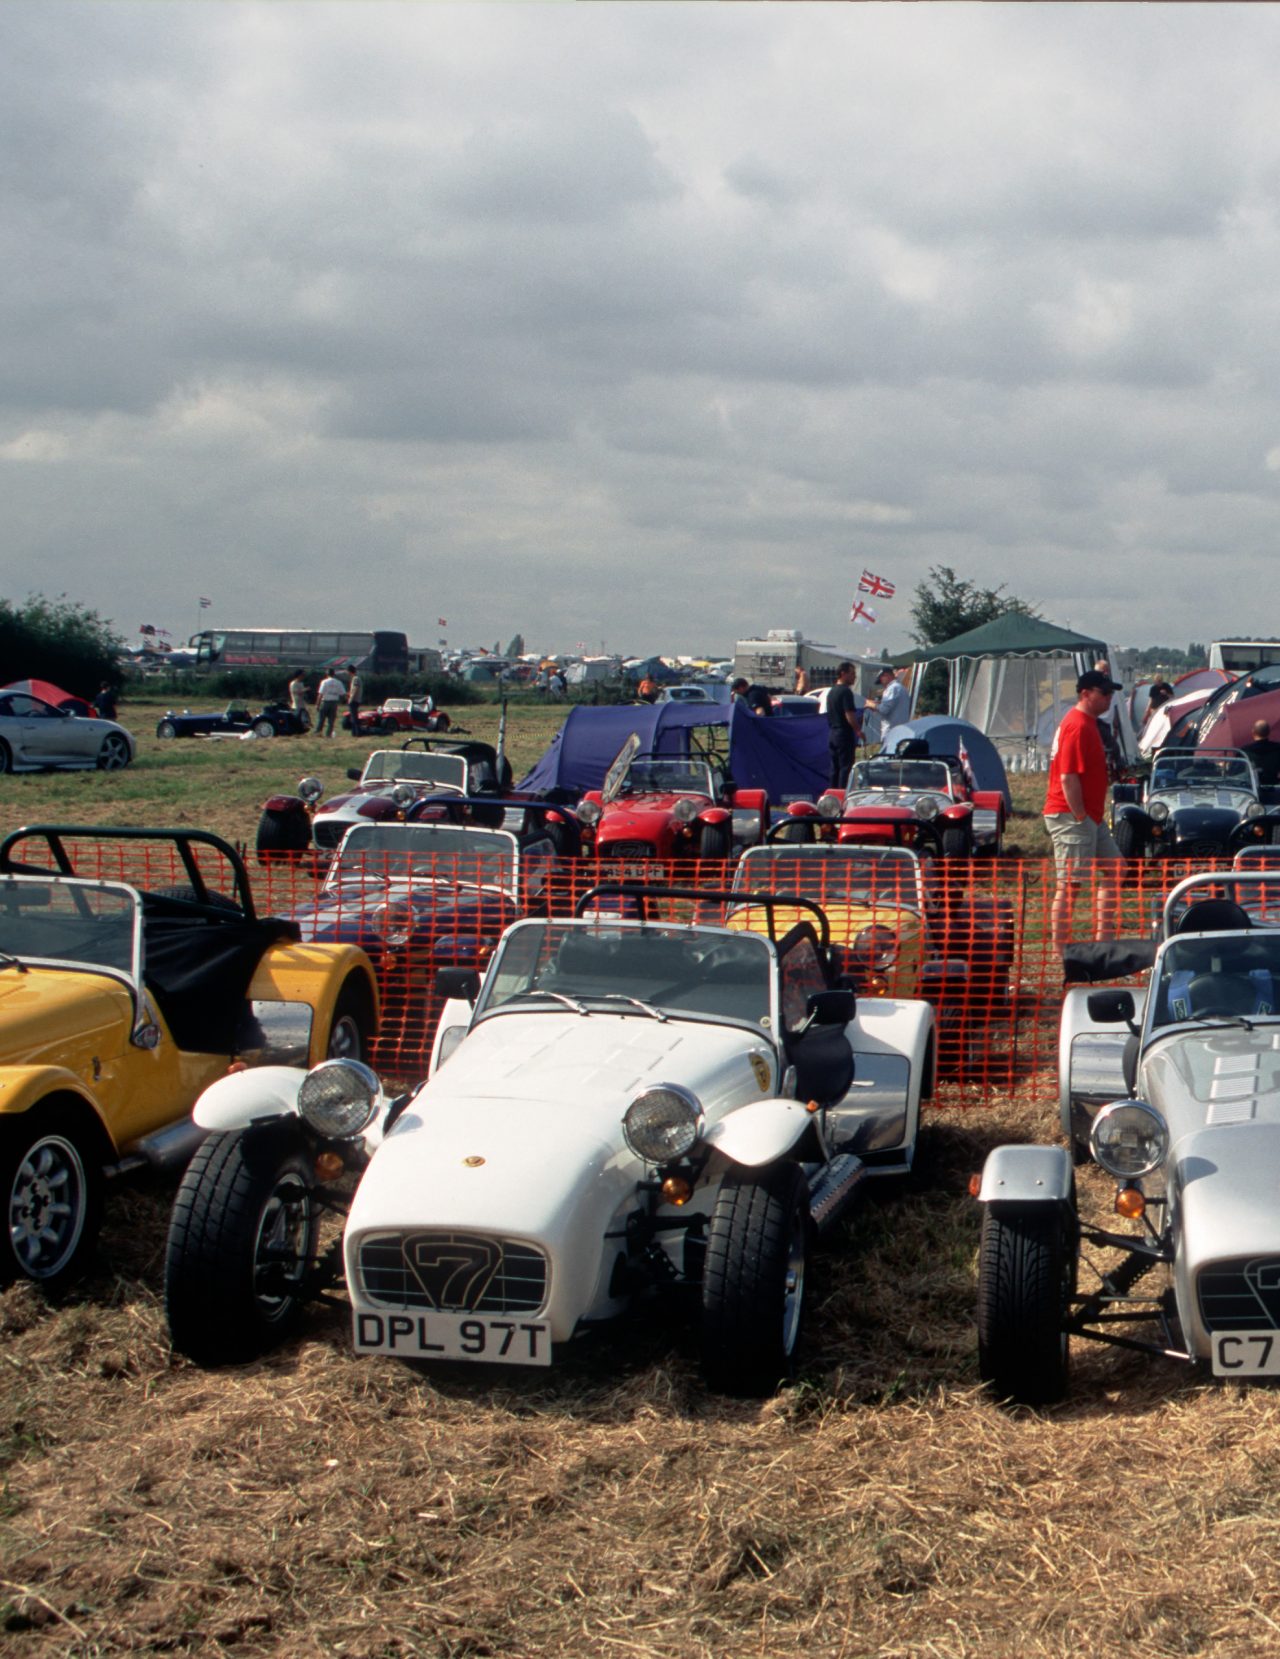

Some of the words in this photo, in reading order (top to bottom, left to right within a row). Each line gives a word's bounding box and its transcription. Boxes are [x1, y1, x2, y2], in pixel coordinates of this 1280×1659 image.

[416, 1242, 491, 1308] 7
[357, 1314, 445, 1351] DPL
[459, 1320, 546, 1358] 97T
[1218, 1336, 1273, 1369] C7
